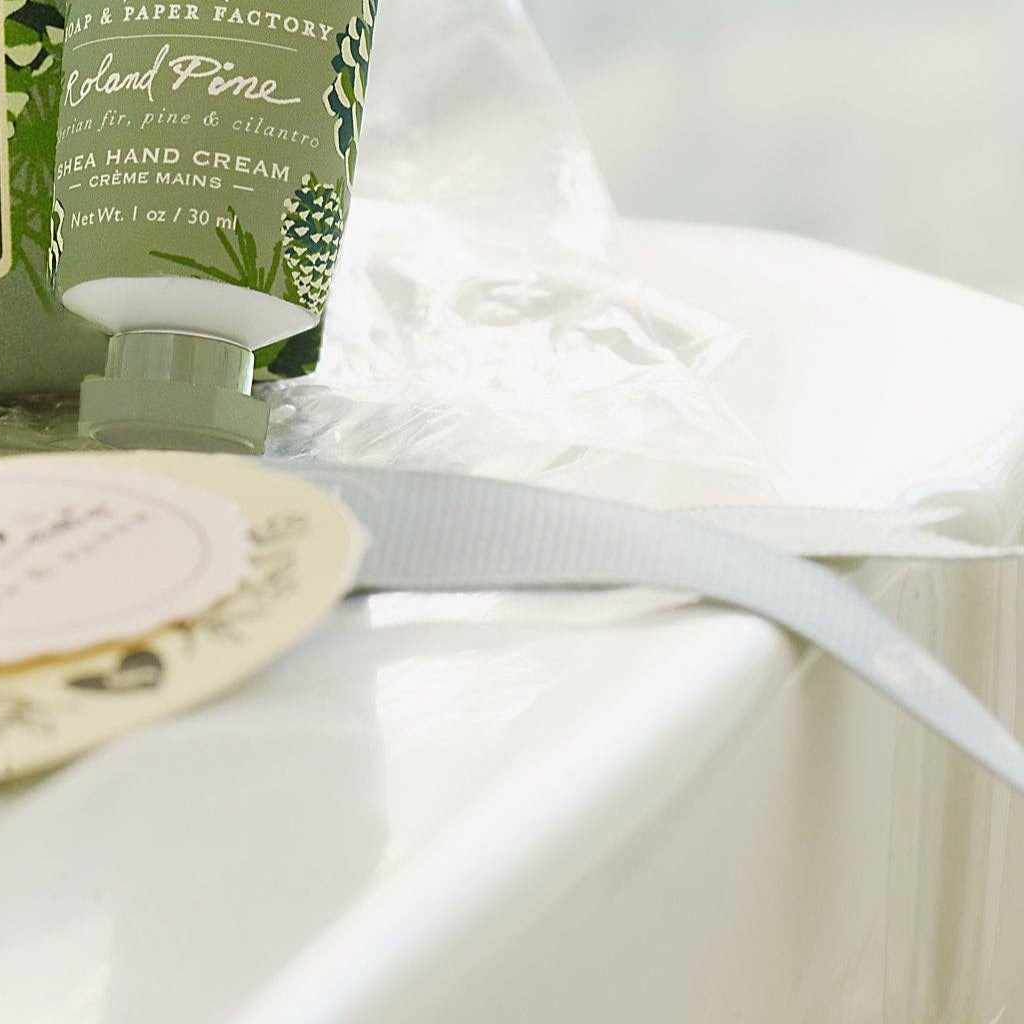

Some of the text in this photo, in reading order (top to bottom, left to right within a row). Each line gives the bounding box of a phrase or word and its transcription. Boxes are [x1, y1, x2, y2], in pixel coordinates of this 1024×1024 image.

[101, 8, 112, 25] &
[122, 4, 200, 23] PAPER
[214, 5, 334, 41] FACTORY
[64, 44, 301, 107] Roland Pine
[98, 109, 131, 132] fir,
[141, 108, 191, 129] pine
[203, 111, 219, 126] &
[232, 117, 319, 149] cilantro
[57, 148, 291, 182] SHEA HAND CREAM
[89, 170, 222, 189] CRÈME MAINS
[70, 213, 94, 229] Net
[97, 207, 124, 222] Wt.
[146, 209, 166, 221] oz
[188, 209, 209, 225] 30
[216, 215, 238, 230] ml
